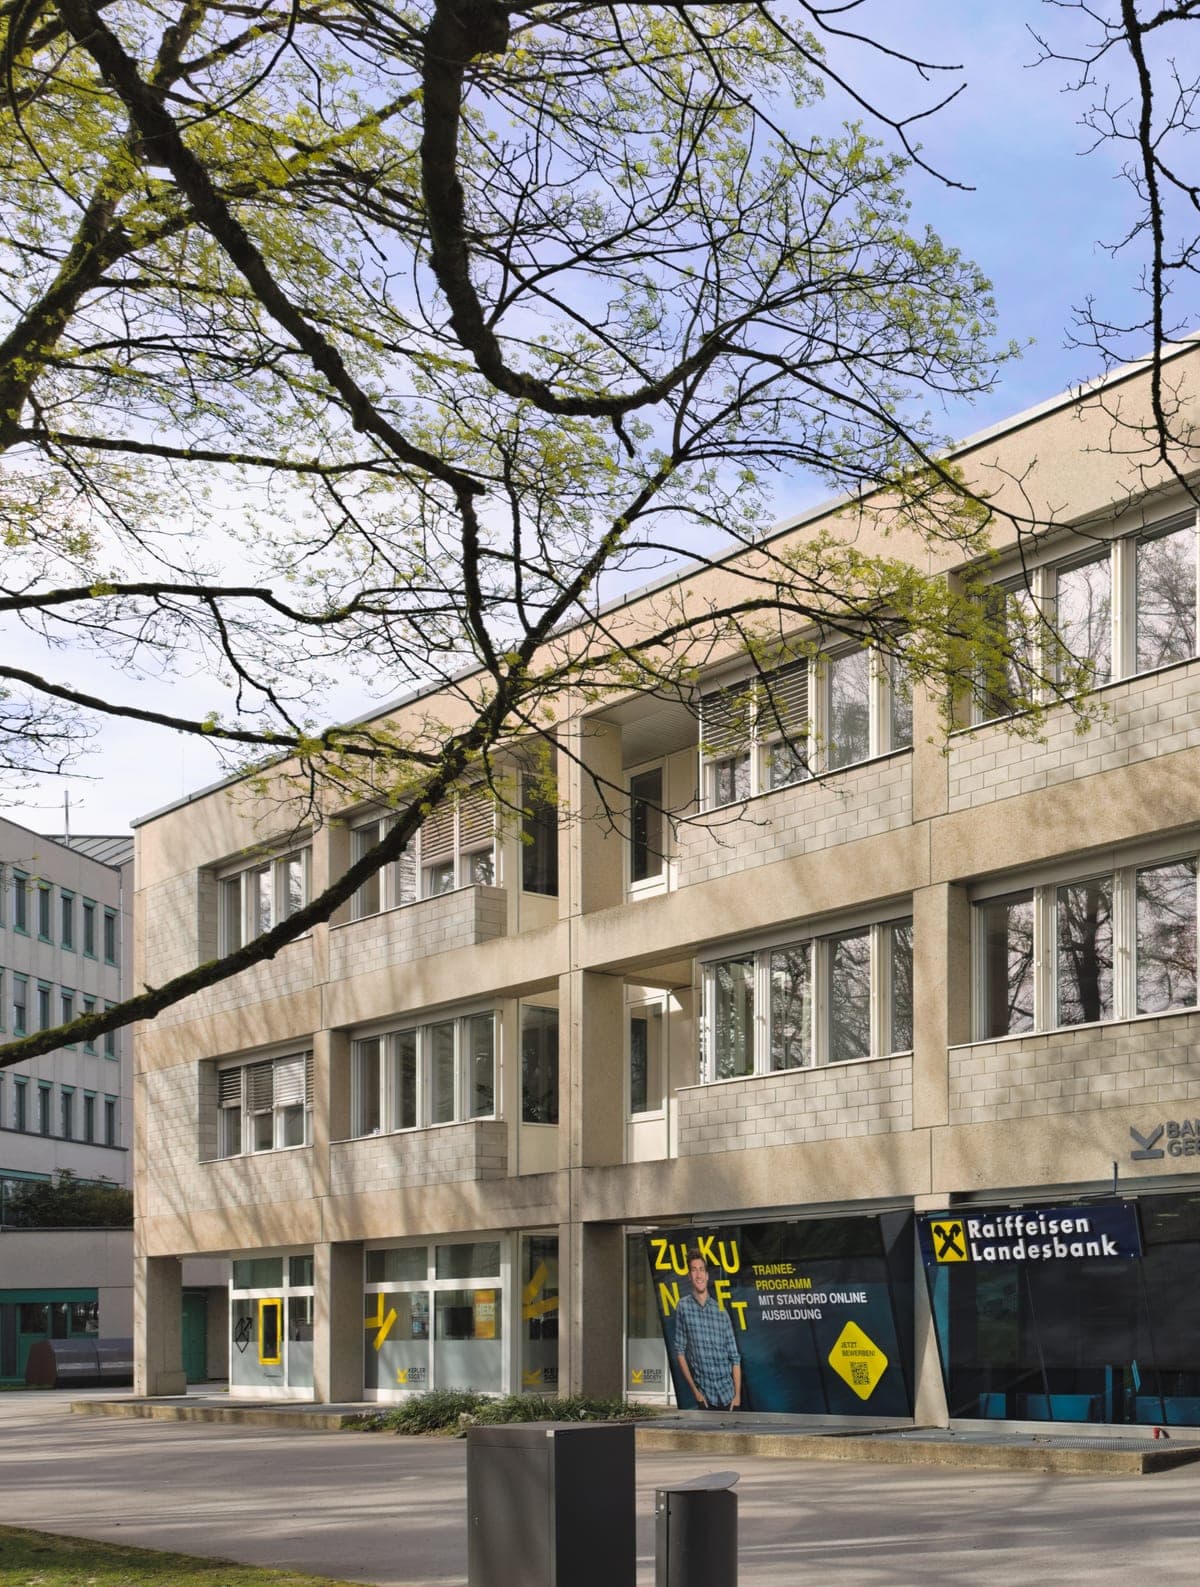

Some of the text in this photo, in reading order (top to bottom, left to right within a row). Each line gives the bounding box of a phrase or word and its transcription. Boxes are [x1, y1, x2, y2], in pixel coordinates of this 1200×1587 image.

[967, 1214, 1089, 1238] Raiffeisen
[971, 1234, 1119, 1261] Landesbank
[752, 1264, 796, 1275] TRAINEE-
[755, 1278, 812, 1291] PROGRAMM
[758, 1291, 868, 1306] MIT STANFORD ONLINE
[761, 1308, 823, 1321] AUSBILDUNG
